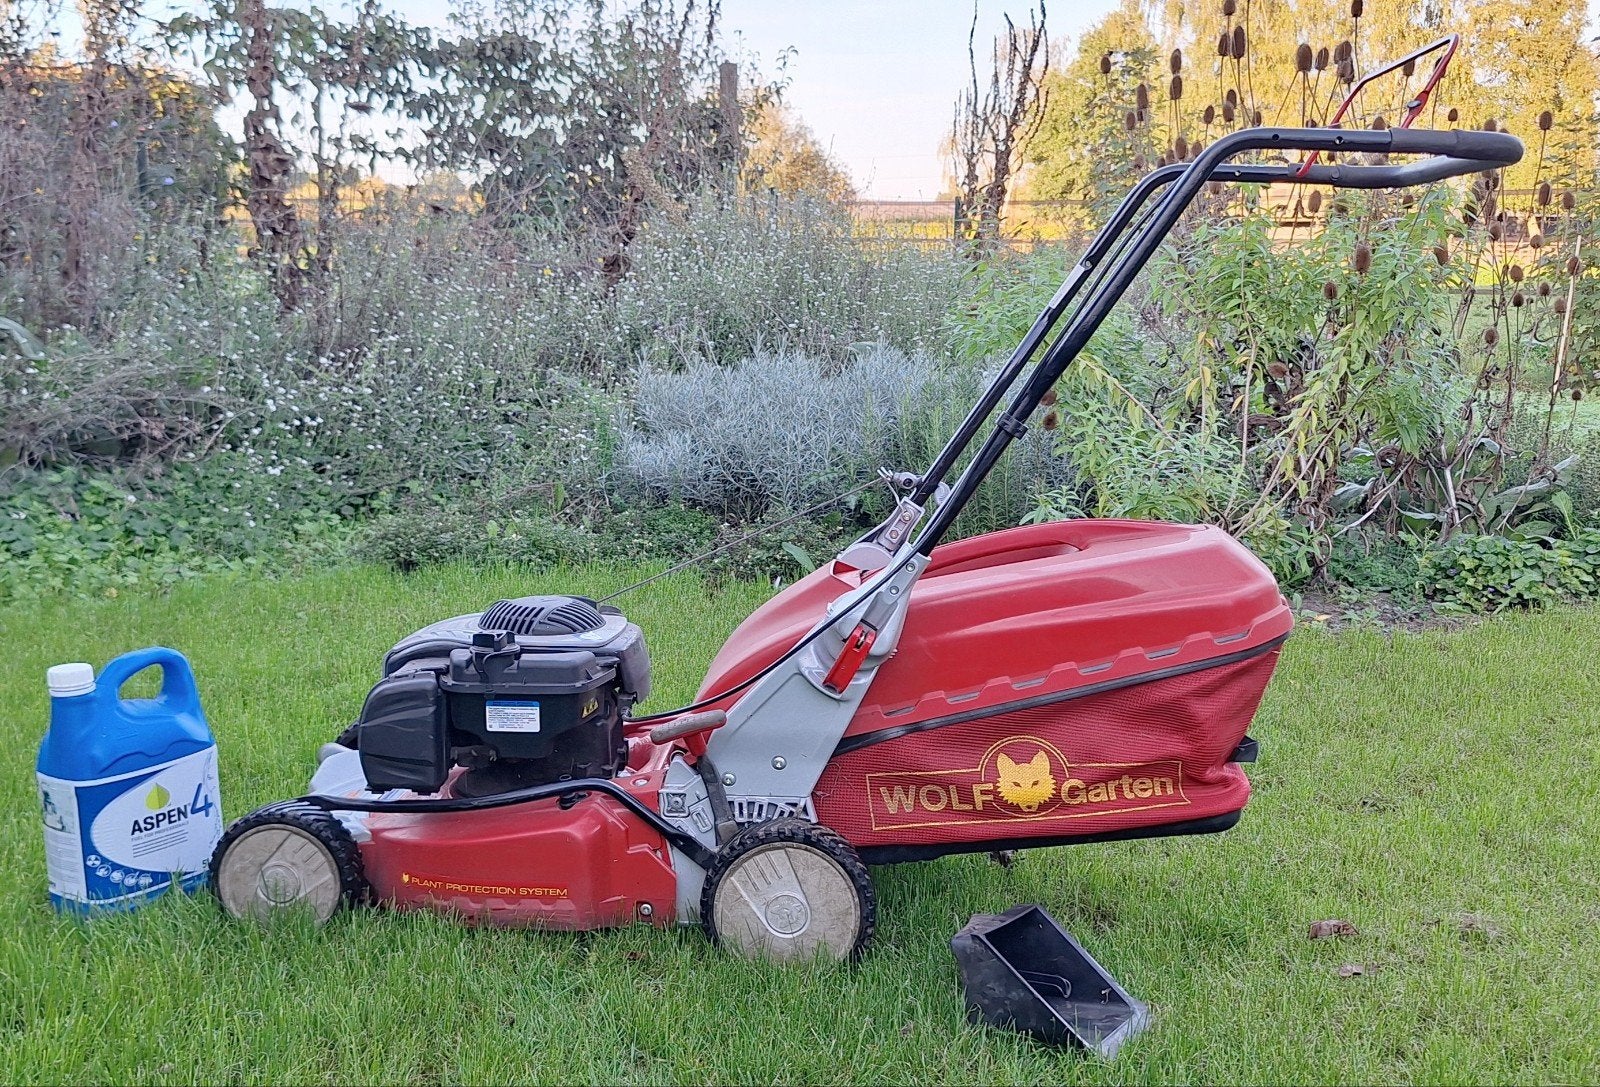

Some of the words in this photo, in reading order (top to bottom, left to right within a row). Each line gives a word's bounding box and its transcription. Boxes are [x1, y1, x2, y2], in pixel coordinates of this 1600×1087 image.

[131, 804, 188, 836] ASPEN
[190, 783, 214, 817] 4
[879, 782, 995, 814] WOLF
[1060, 773, 1174, 805] Garten
[411, 876, 444, 889] PLANT
[445, 882, 517, 895] PROTECTION
[519, 886, 568, 897] SYSTEM
